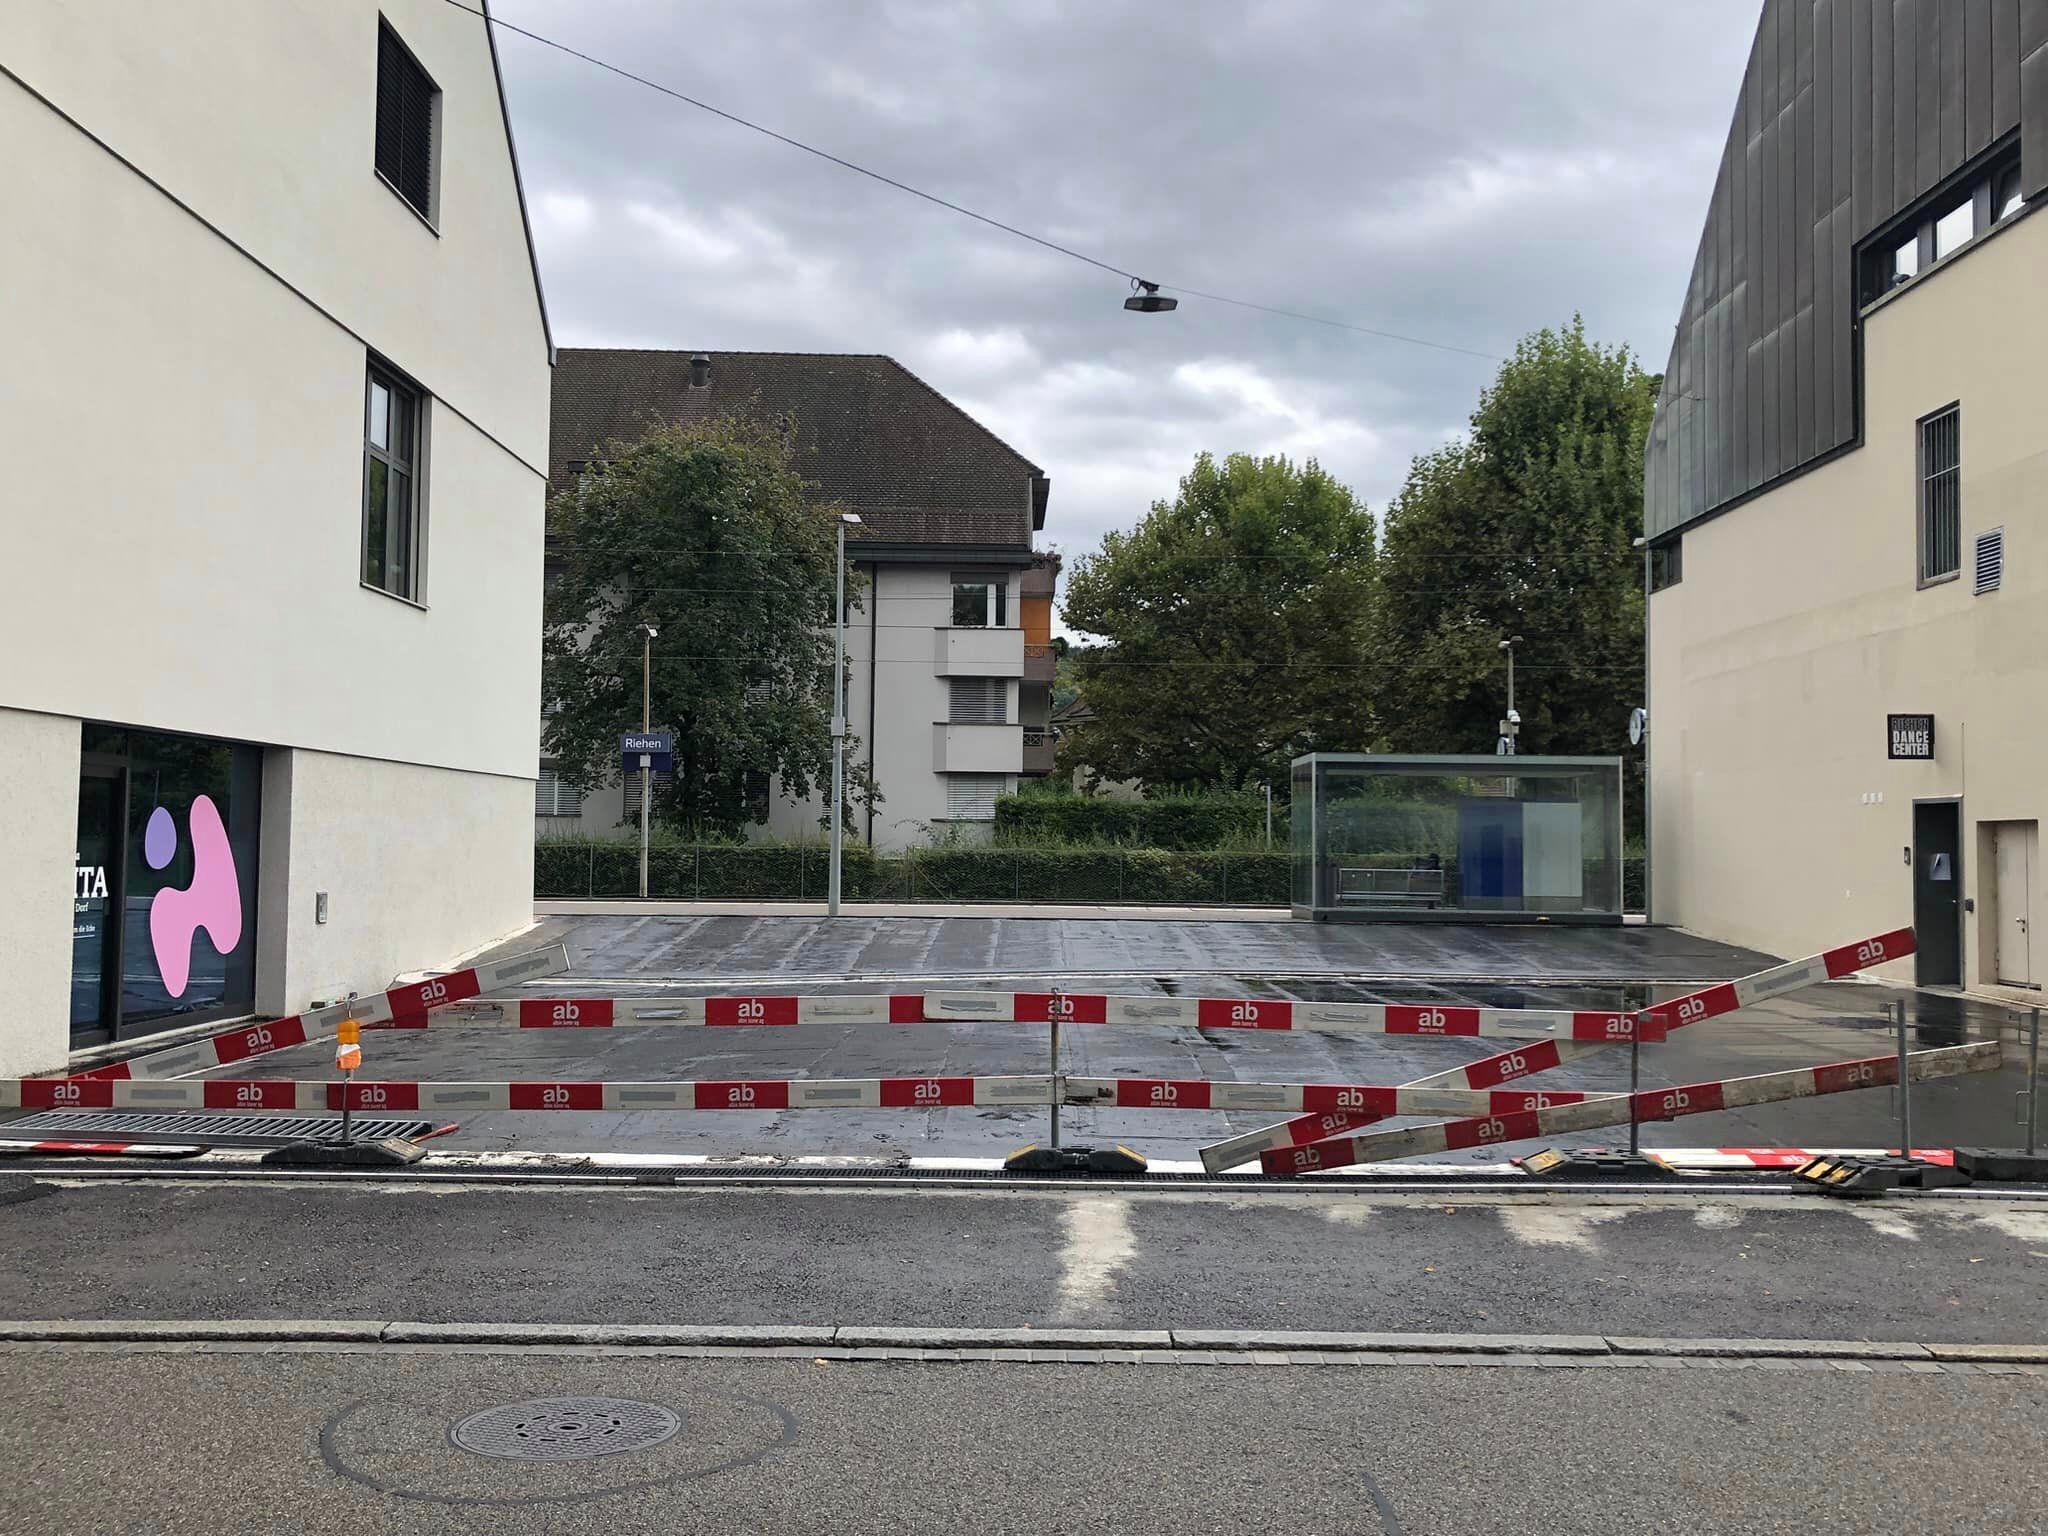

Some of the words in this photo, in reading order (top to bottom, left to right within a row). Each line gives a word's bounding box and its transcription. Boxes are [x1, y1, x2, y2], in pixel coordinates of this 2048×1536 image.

[625, 738, 661, 748] Riehen
[1893, 731, 1929, 743] DANCE
[1893, 743, 1929, 755] CENTER
[1858, 939, 1884, 961] ab
[420, 980, 446, 1001] ab
[552, 1000, 580, 1020] ab
[738, 998, 765, 1017] ab
[1047, 996, 1074, 1015] ab
[1231, 1002, 1258, 1021] ab
[1678, 997, 1705, 1018] ab
[1418, 1008, 1445, 1027] ab
[1606, 1014, 1633, 1033] ab
[246, 1026, 273, 1048] ab
[1499, 1053, 1526, 1075] ab
[1847, 1063, 1873, 1081] ab
[54, 1081, 80, 1100] ab
[237, 1082, 263, 1101] ab
[360, 1084, 386, 1103] ab
[543, 1084, 569, 1103] ab
[728, 1083, 755, 1102] ab
[914, 1080, 941, 1098] ab
[1150, 1082, 1177, 1101] ab
[1337, 1088, 1364, 1106] ab
[1523, 1093, 1550, 1110] ab
[1663, 1090, 1689, 1109] ab
[1321, 1112, 1348, 1130] ab
[1478, 1117, 1504, 1137] ab
[1294, 1146, 1320, 1165] ab
